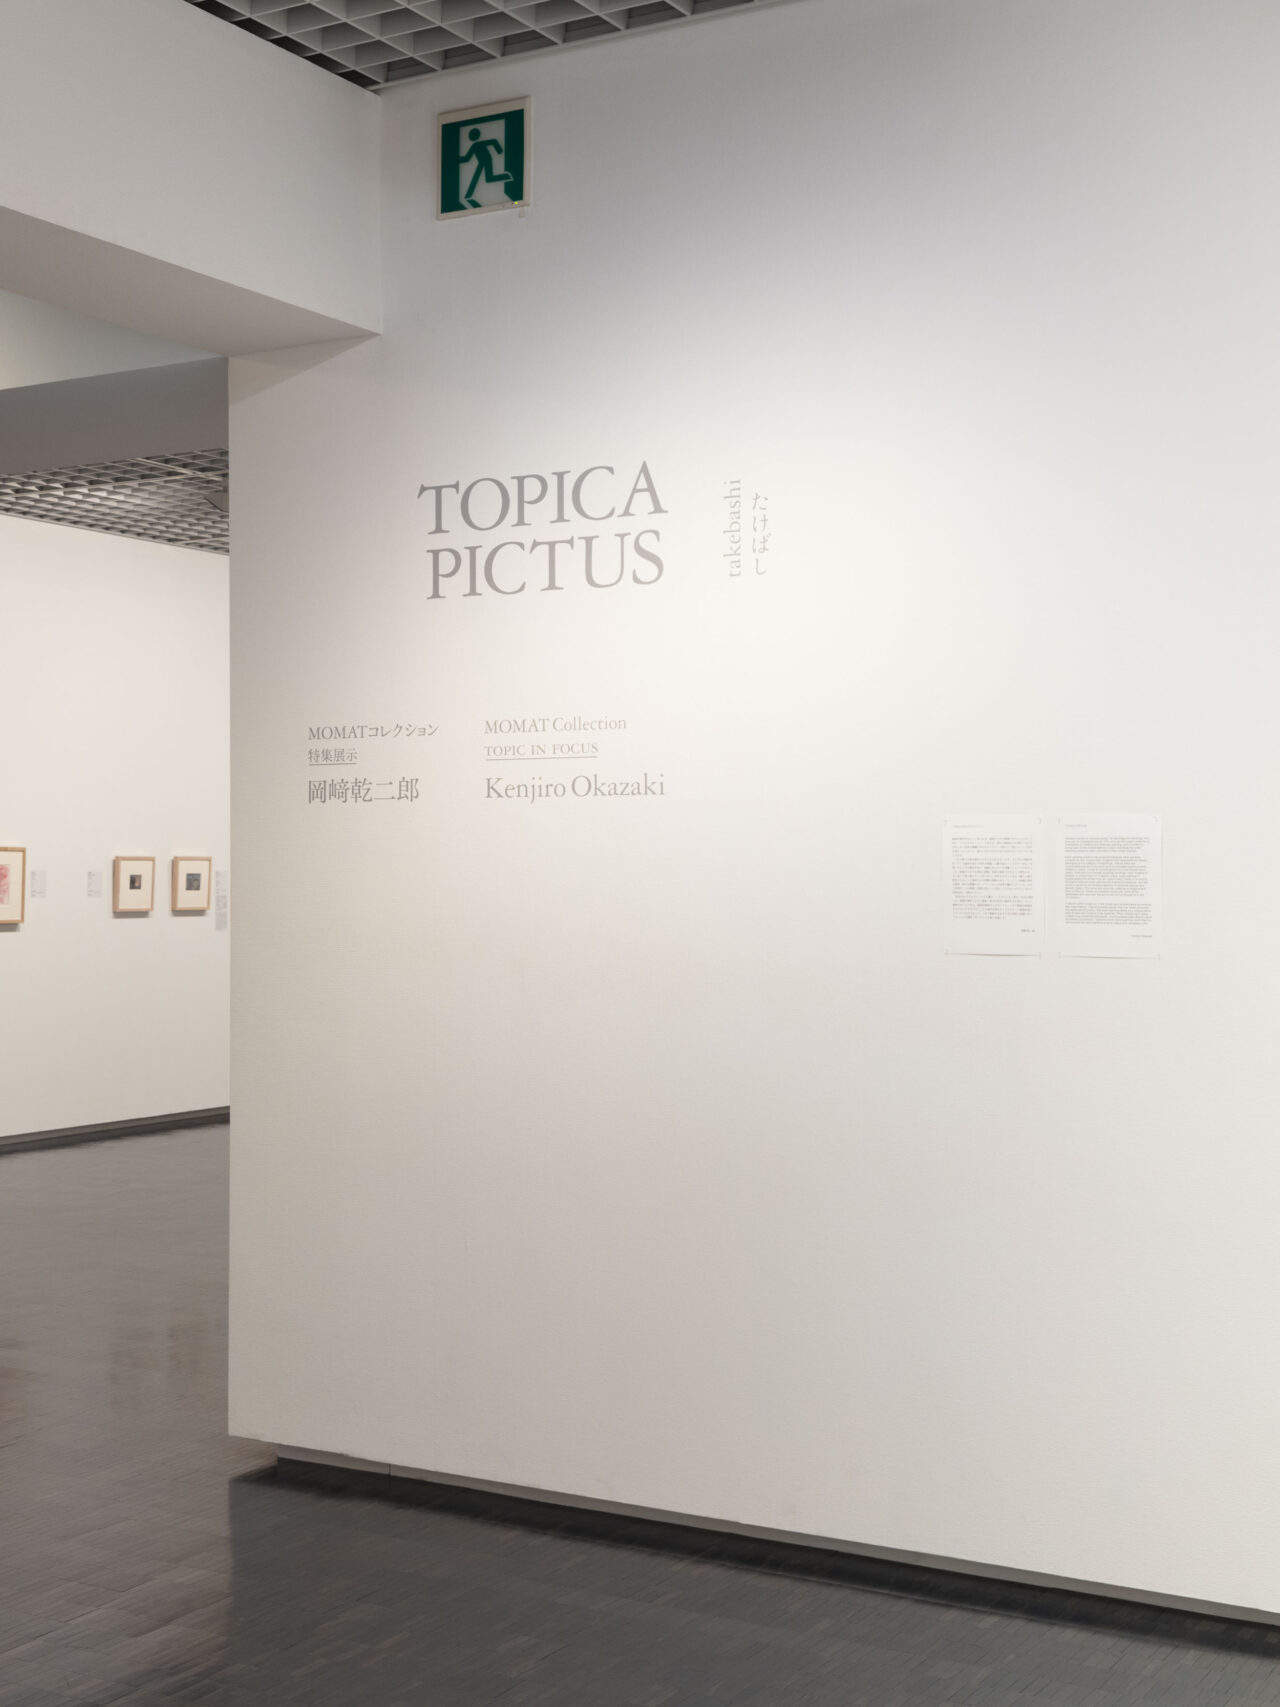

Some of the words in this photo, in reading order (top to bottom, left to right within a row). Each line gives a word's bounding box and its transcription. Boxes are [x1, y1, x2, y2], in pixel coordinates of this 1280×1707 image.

[417, 460, 669, 535] TOPICA
[722, 479, 742, 578] takebashi
[752, 492, 772, 576] たけばし
[425, 529, 664, 600] PICTUS
[308, 723, 439, 740] MOMATコレクション
[484, 718, 550, 735] MOMAT
[552, 716, 627, 733] Collection
[308, 748, 358, 763] 特集展示
[484, 744, 526, 757] TOPIC
[530, 743, 547, 756] IN
[551, 742, 599, 755] FOCUS
[484, 776, 567, 805] Kenjiro
[570, 773, 665, 799] Okazaki
